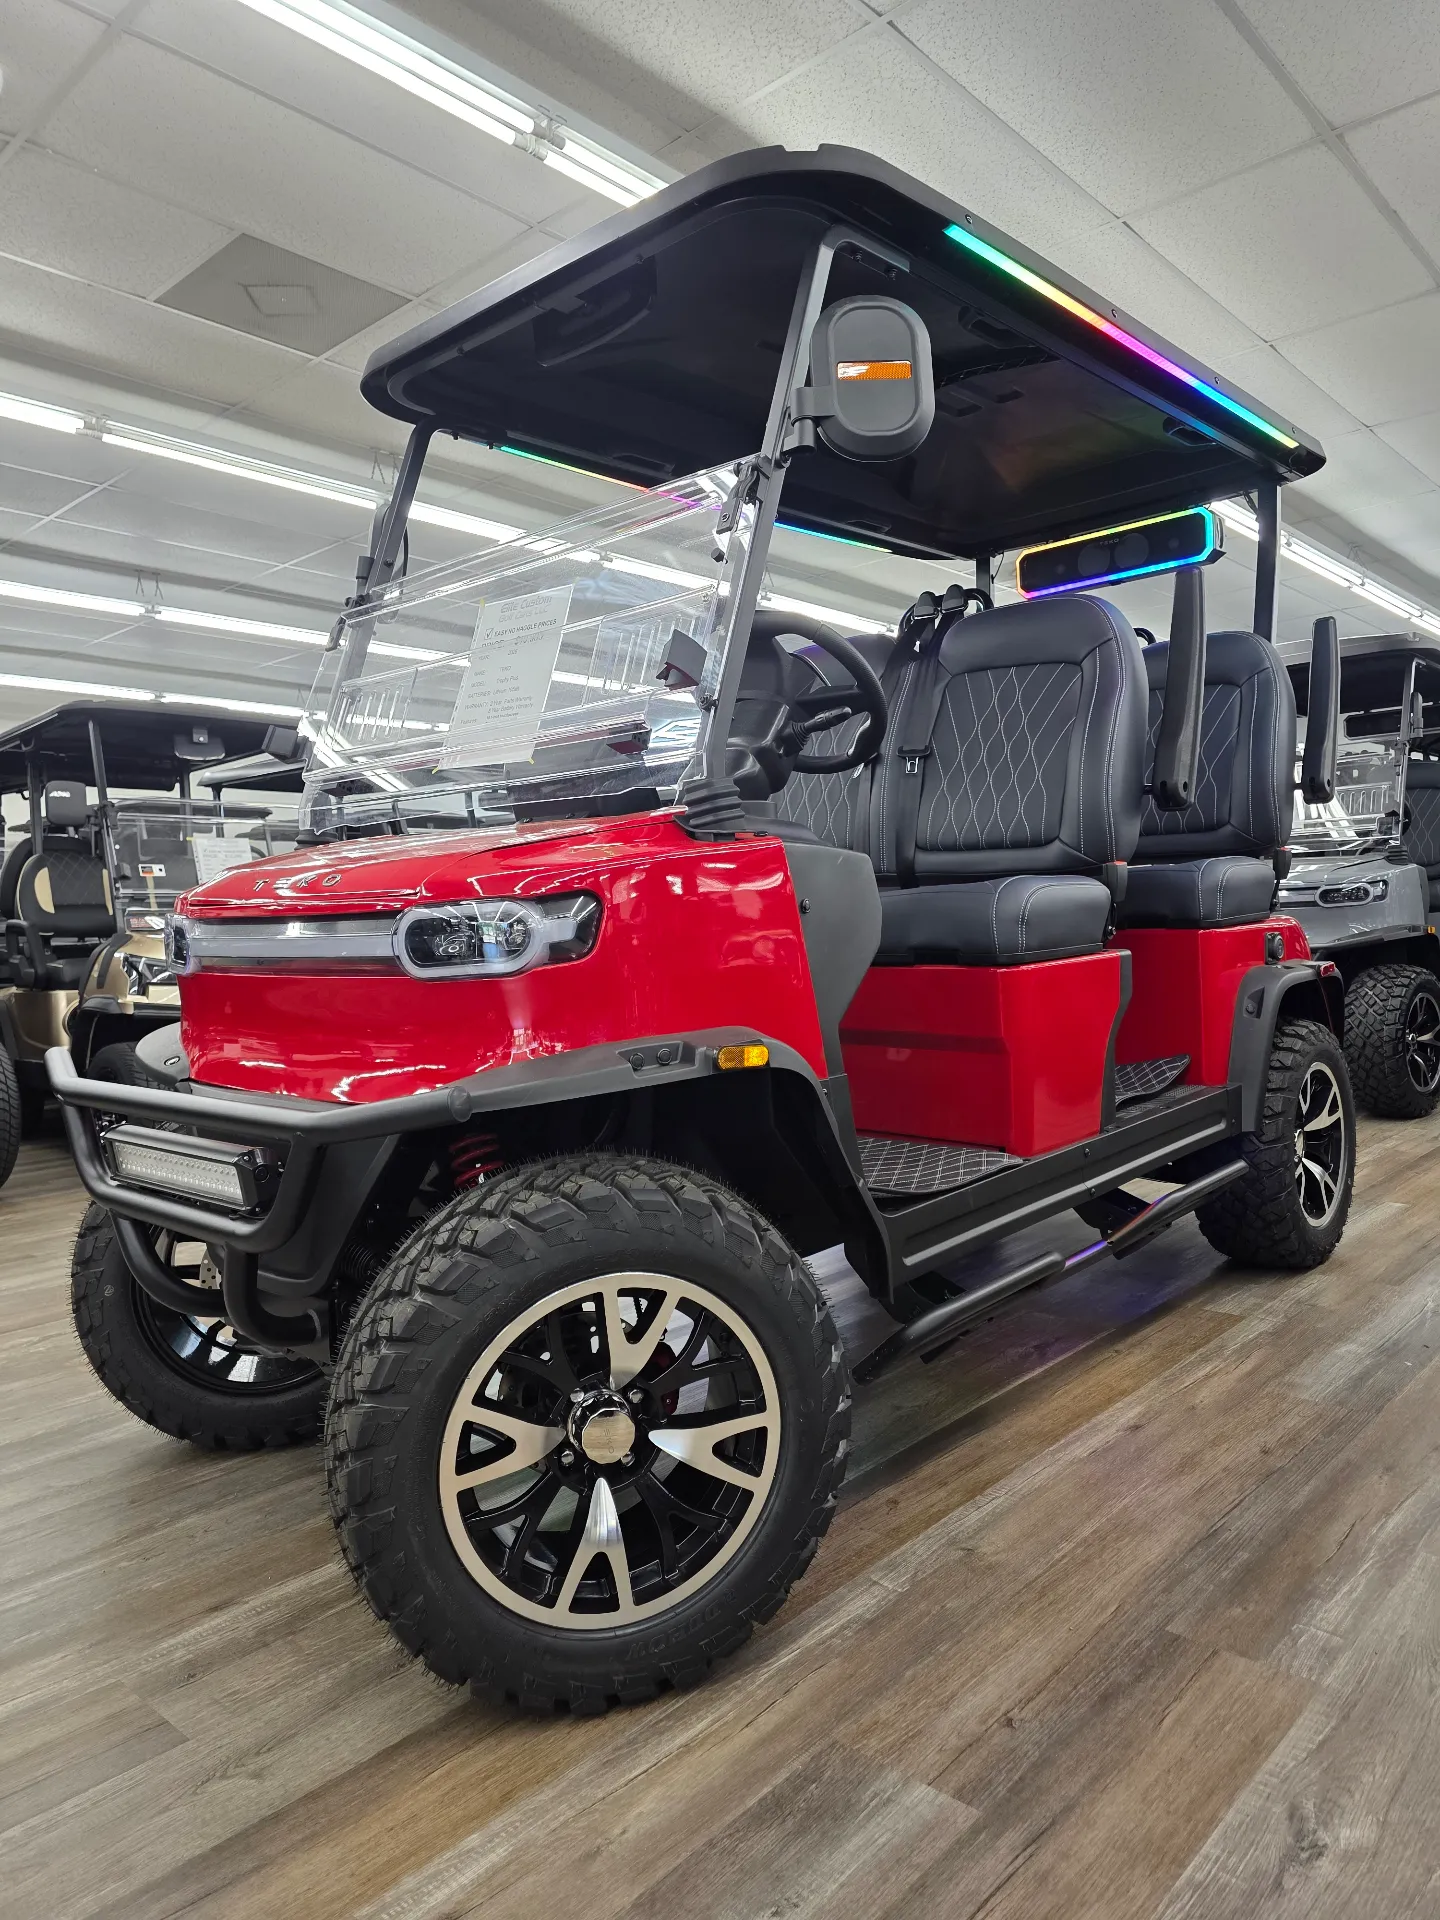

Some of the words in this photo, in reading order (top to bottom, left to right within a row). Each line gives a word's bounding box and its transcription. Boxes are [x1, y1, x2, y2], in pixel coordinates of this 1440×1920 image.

[501, 602, 519, 613] Elite
[521, 596, 552, 609] Custom
[494, 629, 507, 637] EASY
[516, 623, 537, 633] HAGGLE
[538, 618, 557, 629] PRICES
[253, 874, 342, 892] TEKO
